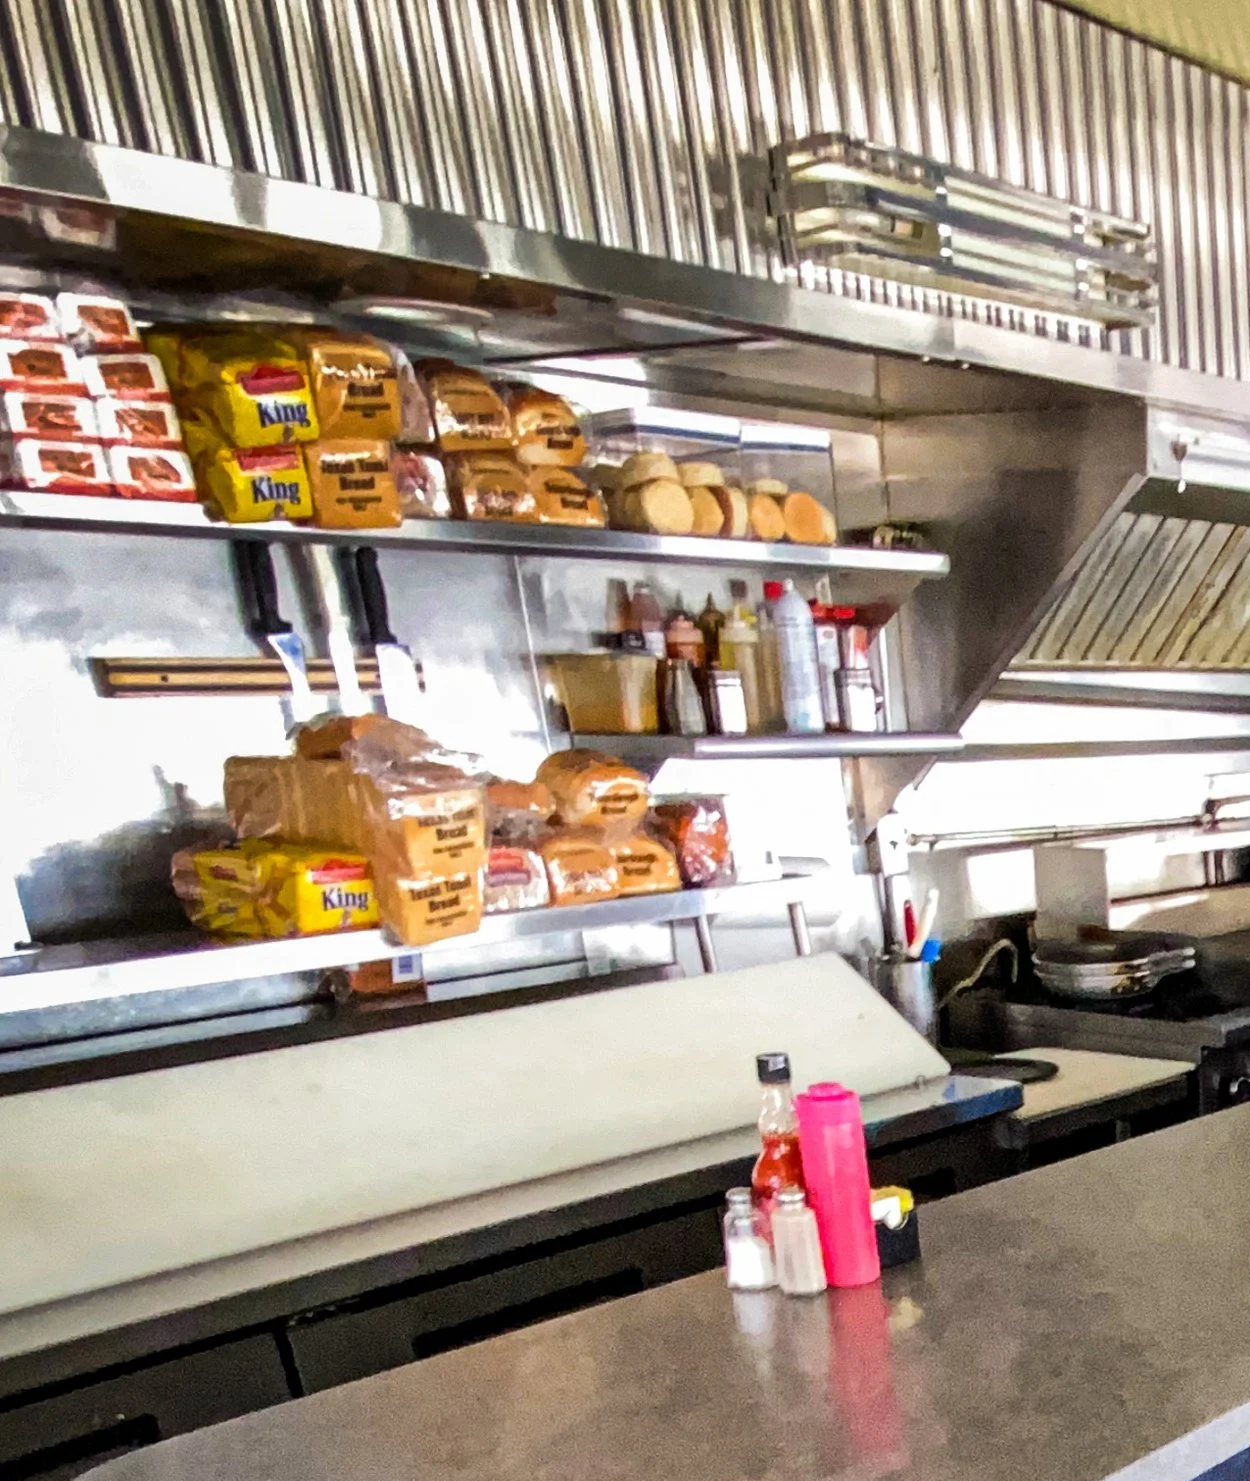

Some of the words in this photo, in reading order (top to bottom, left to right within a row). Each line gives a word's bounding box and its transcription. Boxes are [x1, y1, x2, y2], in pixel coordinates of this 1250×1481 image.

[257, 401, 310, 428] King
[252, 476, 301, 504] King
[436, 824, 467, 841] Bread
[321, 887, 368, 912] King
[409, 885, 441, 901] Texas
[428, 894, 460, 912] Bread
